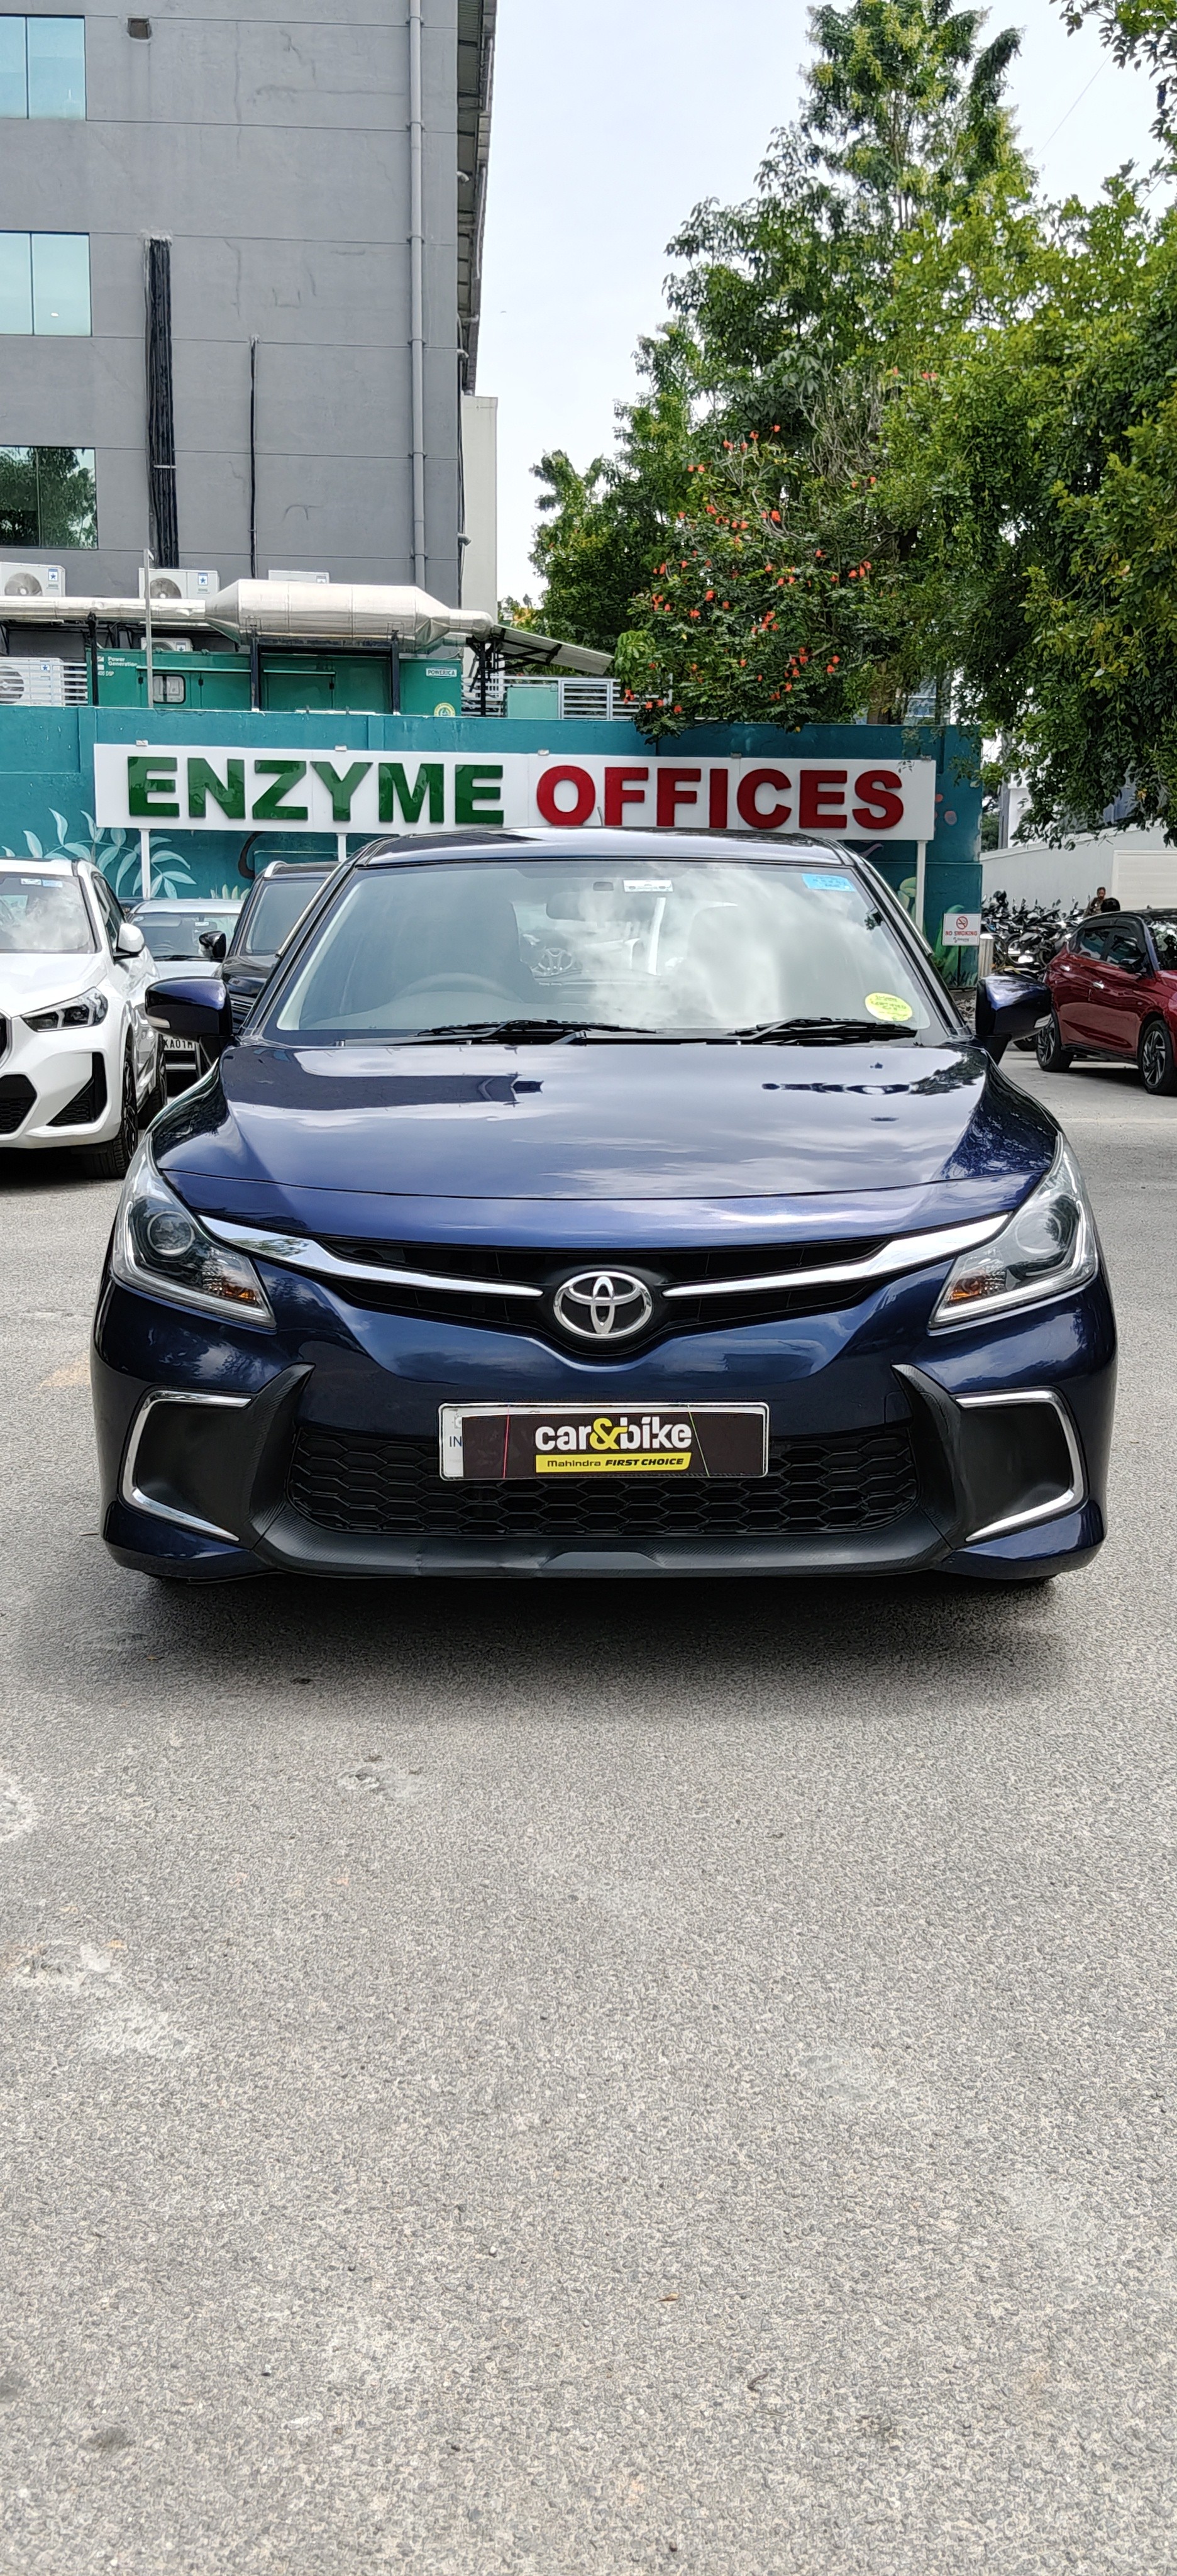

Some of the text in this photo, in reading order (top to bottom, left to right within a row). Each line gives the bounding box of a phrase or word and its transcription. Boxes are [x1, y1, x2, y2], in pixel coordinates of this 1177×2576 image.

[128, 756, 904, 829] ENZYME OFFICES
[535, 1416, 692, 1451] car&bike
